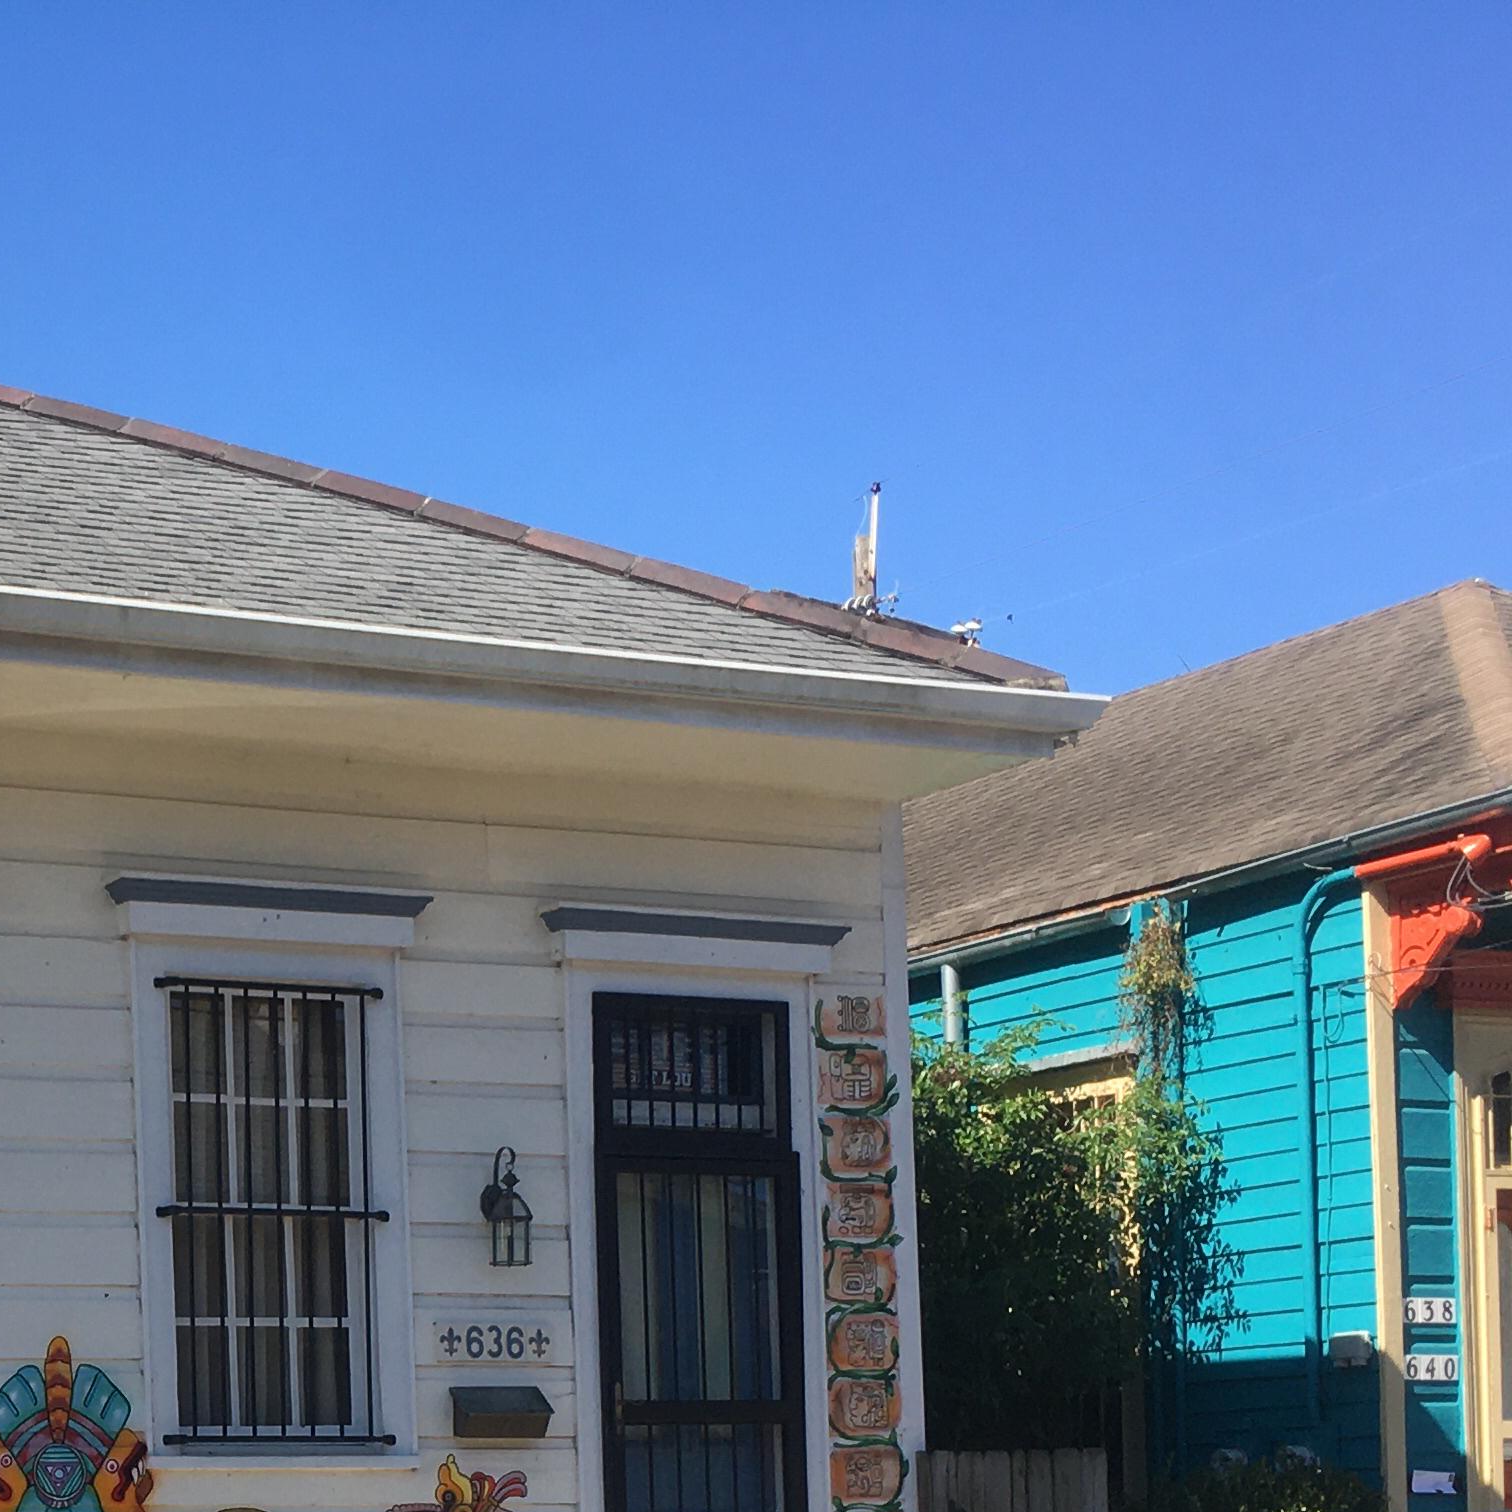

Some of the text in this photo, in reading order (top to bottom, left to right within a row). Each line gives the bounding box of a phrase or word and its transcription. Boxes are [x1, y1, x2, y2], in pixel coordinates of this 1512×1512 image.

[1405, 1300, 1453, 1322] 638
[465, 1325, 524, 1359] 636
[1406, 1356, 1455, 1379] 640
